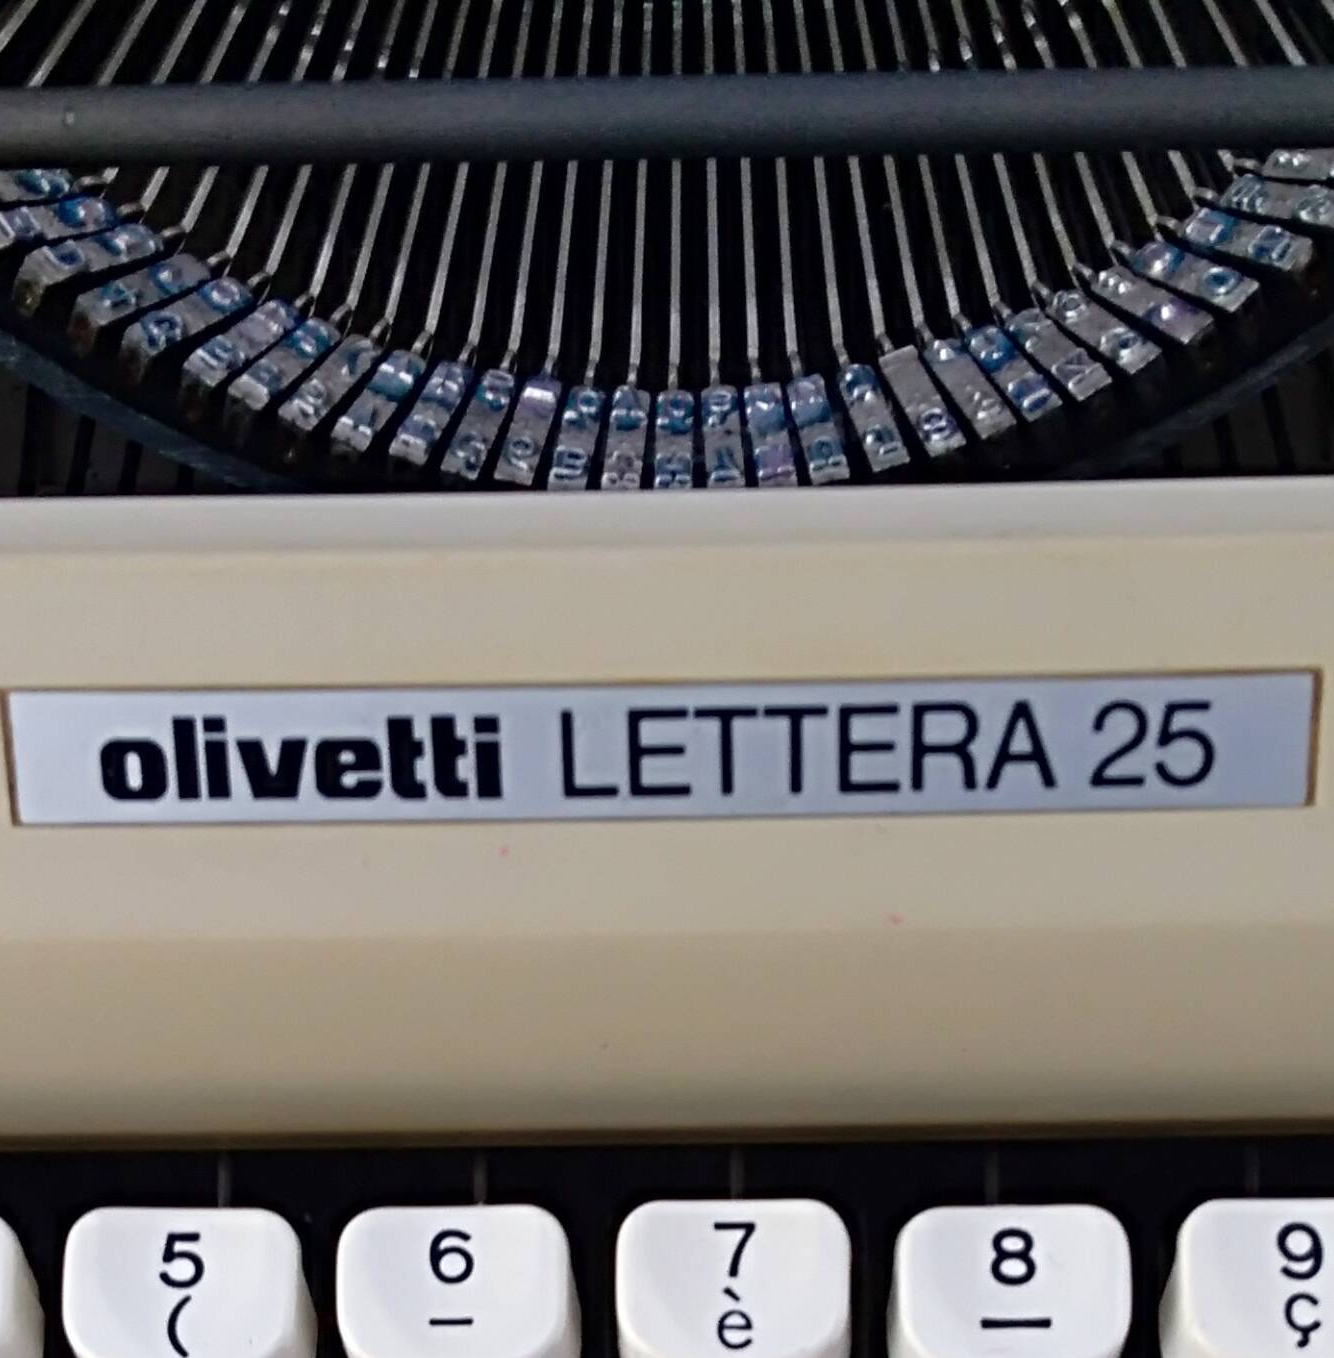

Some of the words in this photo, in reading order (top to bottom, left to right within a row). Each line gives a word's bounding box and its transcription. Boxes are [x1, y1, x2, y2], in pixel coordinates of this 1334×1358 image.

[100, 715, 503, 801] olivetti
[560, 700, 1058, 799] LETTERA
[1089, 700, 1216, 789] 25
[159, 1232, 204, 1288] 5
[430, 1230, 474, 1284] 6
[714, 1222, 755, 1277] 7
[991, 1228, 1036, 1286] 8
[1277, 1223, 1323, 1280] 9
[167, 1296, 191, 1358] (
[717, 1287, 752, 1350] è
[1284, 1293, 1321, 1348] ç
